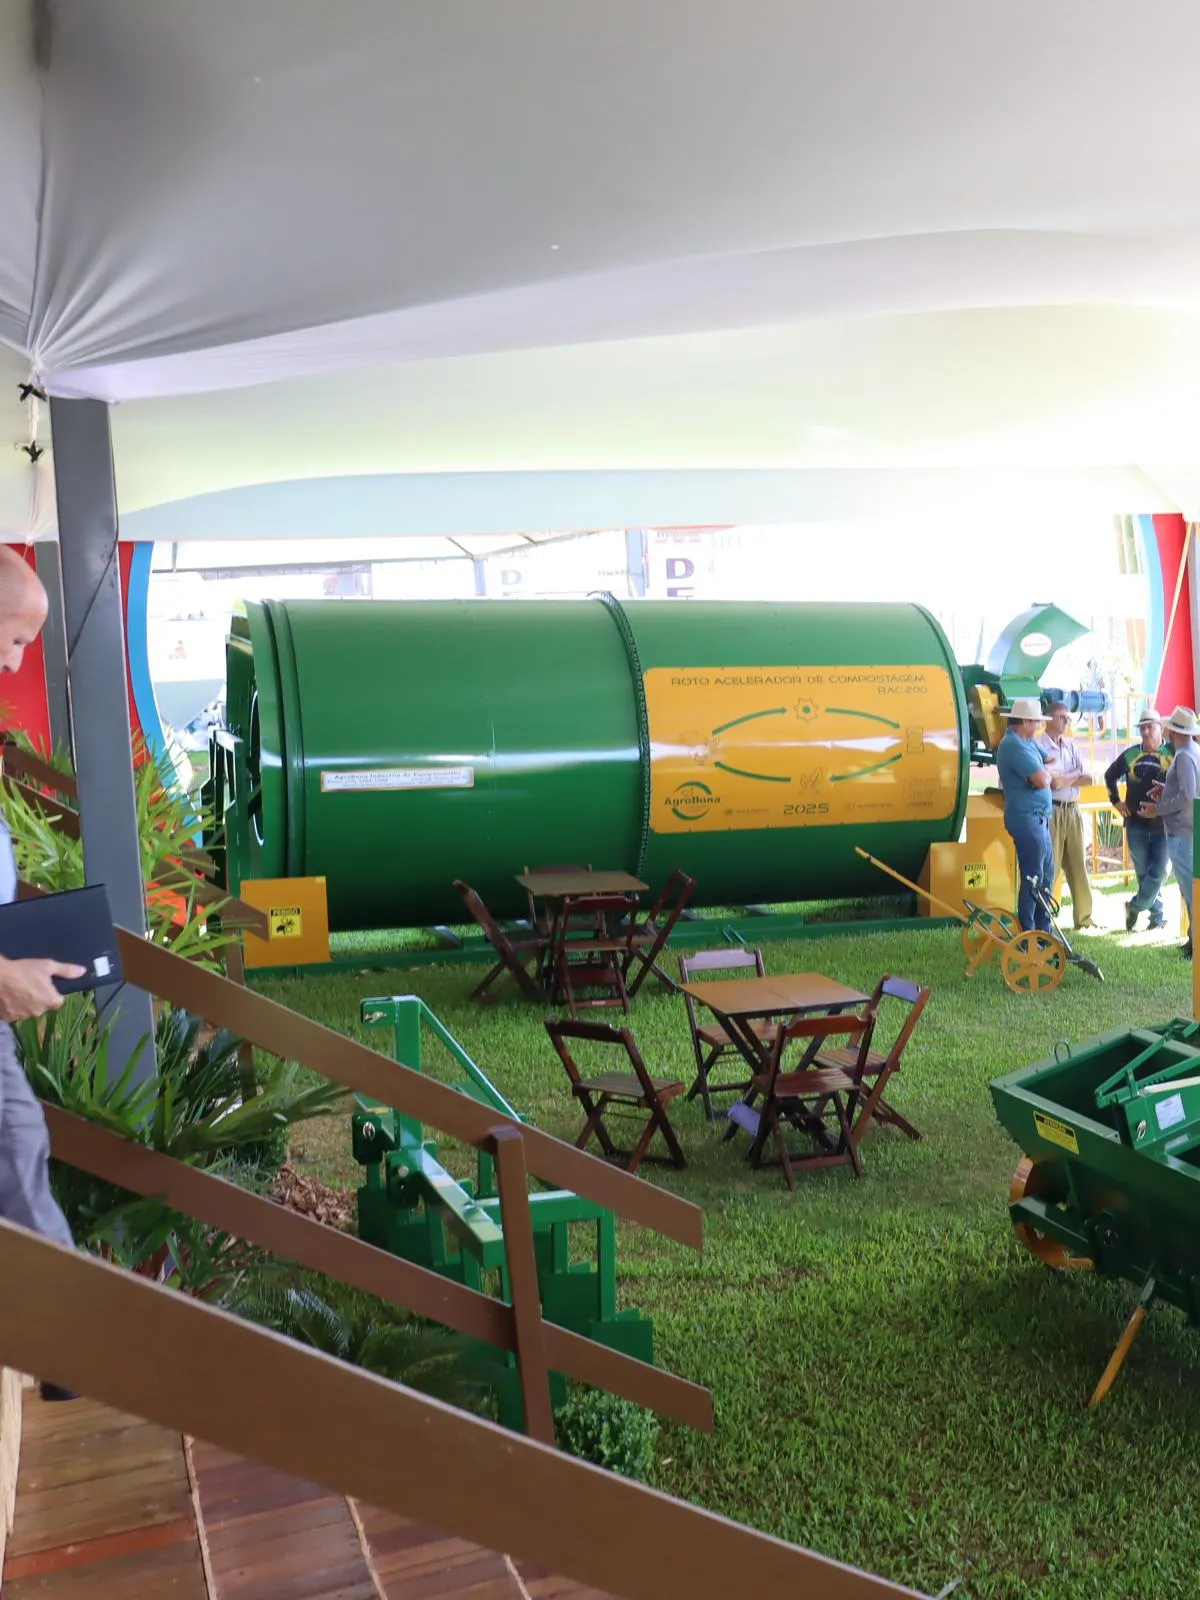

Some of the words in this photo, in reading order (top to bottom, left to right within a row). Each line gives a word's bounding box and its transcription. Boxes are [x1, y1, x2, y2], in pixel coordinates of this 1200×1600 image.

[671, 676, 709, 685] ROTO
[714, 675, 802, 685] ACELERADOR
[807, 675, 823, 684] DE
[828, 673, 926, 684] COMPOSTAGEM
[783, 802, 829, 815] 2025
